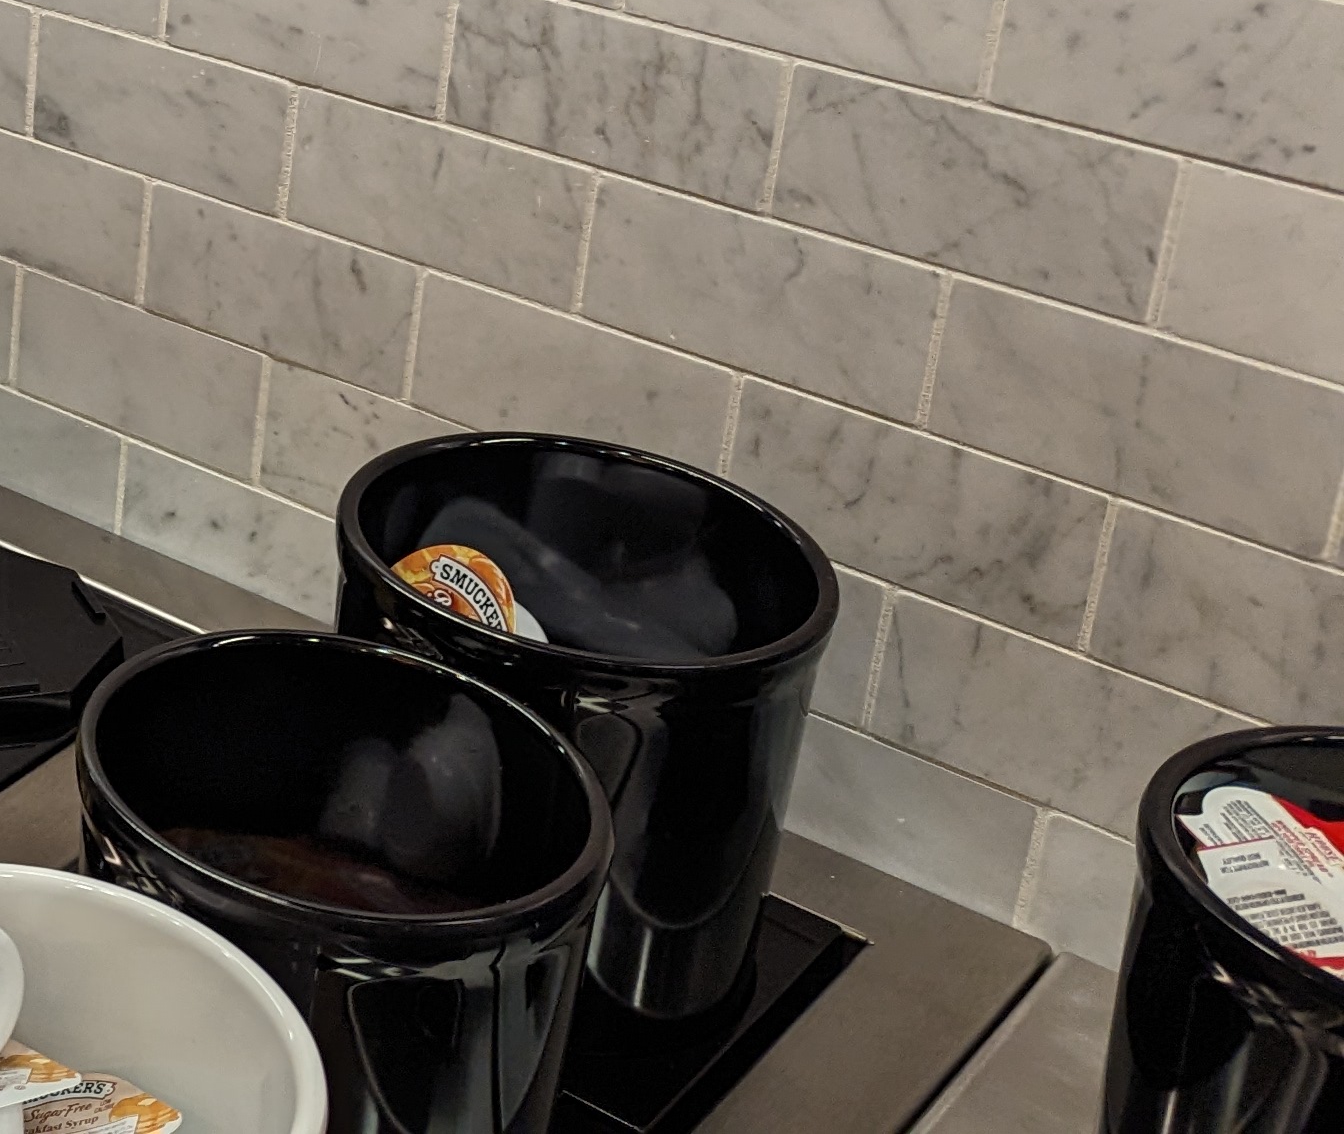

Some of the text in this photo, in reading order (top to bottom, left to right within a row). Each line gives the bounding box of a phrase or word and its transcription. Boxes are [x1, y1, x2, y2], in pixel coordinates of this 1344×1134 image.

[24, 1102, 93, 1124] Sugar Free
[65, 1116, 99, 1130] Syrup
